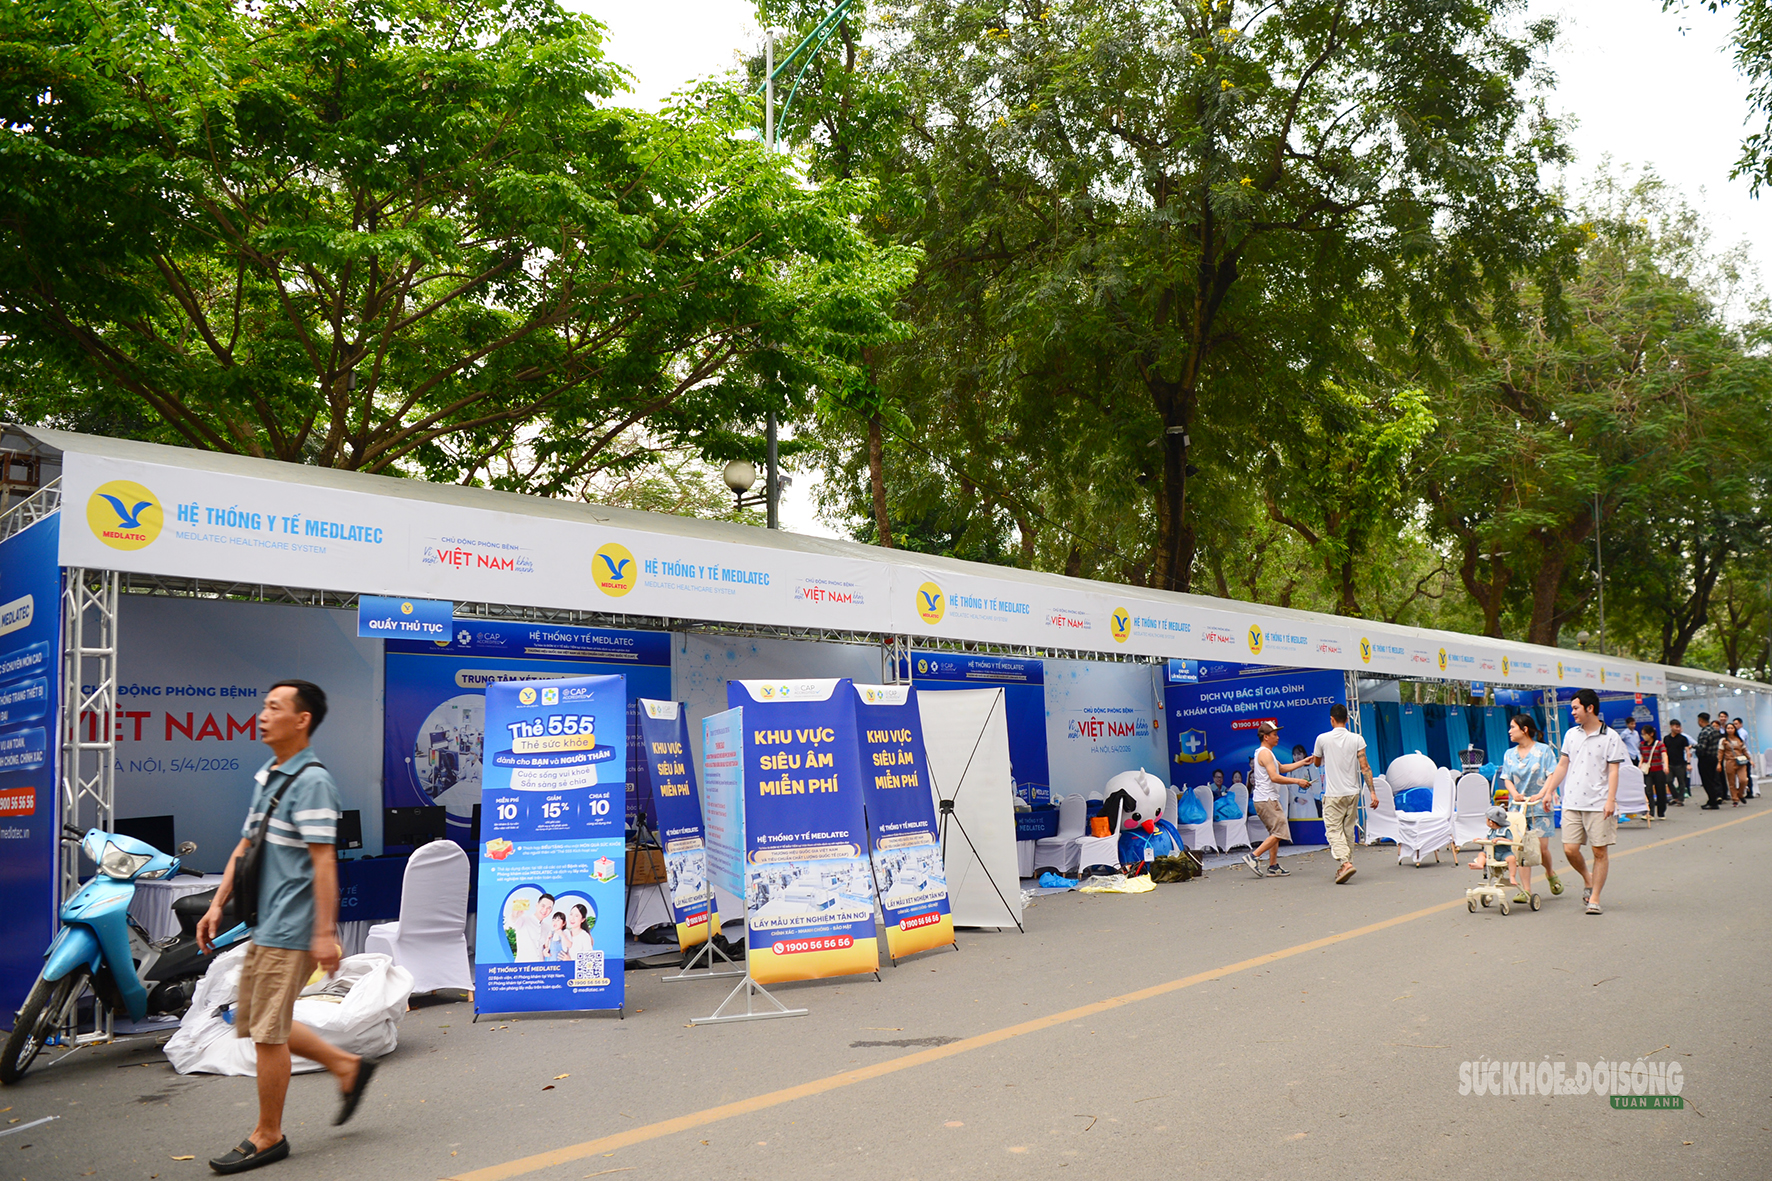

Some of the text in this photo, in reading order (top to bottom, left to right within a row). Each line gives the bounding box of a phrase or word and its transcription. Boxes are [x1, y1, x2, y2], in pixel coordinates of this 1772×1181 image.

[177, 502, 383, 544] HỆ THỐNG Y TẾ MEDLATEC
[103, 530, 146, 542] MEDLATEC
[176, 531, 327, 554] MEDLATEC HEALTHCARE SYSTEM
[436, 547, 514, 571] VIỆT NAM
[644, 558, 770, 586] HỆ THỐNG Y TẾ MEDLATEC
[601, 582, 628, 590] MEDLATEC
[644, 580, 736, 595] MEDLATEC HEALTHCARE SYSTEM
[802, 586, 852, 604] VIỆT NAM
[949, 593, 1030, 615] HỆ THỐNG Y TẾ MEDLATEC
[1, 604, 30, 627] MEDLATEC
[1050, 614, 1084, 629] VIỆT NAM
[399, 619, 421, 631] THỦ
[422, 623, 443, 634] TỤC
[529, 630, 634, 646] HỆ THỐNG Y TẾ MEDLATEC
[461, 674, 496, 684] TRUNG
[117, 684, 162, 698] ĐỘNG
[165, 684, 216, 697] PHÒNG
[219, 685, 257, 699] BỆNH
[570, 687, 587, 696] CAP
[1200, 693, 1221, 703] DỊCH
[1221, 691, 1235, 701] VỤ
[1235, 687, 1254, 698] BÁC
[1265, 687, 1281, 695] GIA
[1282, 684, 1305, 694] ĐÌNH
[1176, 696, 1335, 717] & KHÁM CHỮA BỆNH TỪ XA MEDLATEC
[165, 711, 257, 741] NAM
[508, 715, 595, 740] Thẻ 555
[1077, 716, 1135, 742] VIỆT NAM
[521, 739, 540, 750] Thẻ
[542, 737, 561, 749] sức
[754, 730, 793, 745] KHU
[795, 727, 835, 747] VỰC
[867, 728, 912, 746] KHU VỰC
[652, 741, 683, 758] KHU VỰC
[129, 756, 166, 774] NỘI,
[170, 757, 240, 772] 5/4/2026
[496, 756, 515, 764] dành
[531, 758, 549, 767] BẠN
[587, 750, 611, 761] THÂN
[759, 751, 802, 771] SIÊU
[805, 750, 834, 768] ÂM
[872, 750, 914, 767] SIÊU ÂM
[517, 770, 537, 780] Cuộc
[539, 768, 558, 780] sống
[558, 769, 571, 778] vui
[657, 760, 674, 776] SIÊU
[674, 760, 686, 775] ÂM
[538, 779, 557, 790] sàng
[569, 777, 587, 786] chia
[678, 780, 690, 796] PHÍ
[759, 772, 805, 796] MIỄN
[808, 774, 839, 794] PHÍ
[874, 770, 919, 790] MIỄN PHÍ
[496, 804, 518, 820] 10
[541, 802, 570, 819] 15%
[589, 799, 610, 816] 10
[757, 834, 767, 845] HỆ
[768, 832, 794, 842] THỐNG
[800, 830, 810, 840] TẾ
[811, 831, 849, 839] MEDLATEC
[753, 911, 867, 928] LẤY MẪU XÉT NGHIỆM TẬN NƠI
[905, 914, 940, 928] 1900 56 56 56
[785, 938, 850, 952] 1900 56 56 56
[497, 966, 518, 974] THỐNG
[523, 965, 530, 973] TẾ
